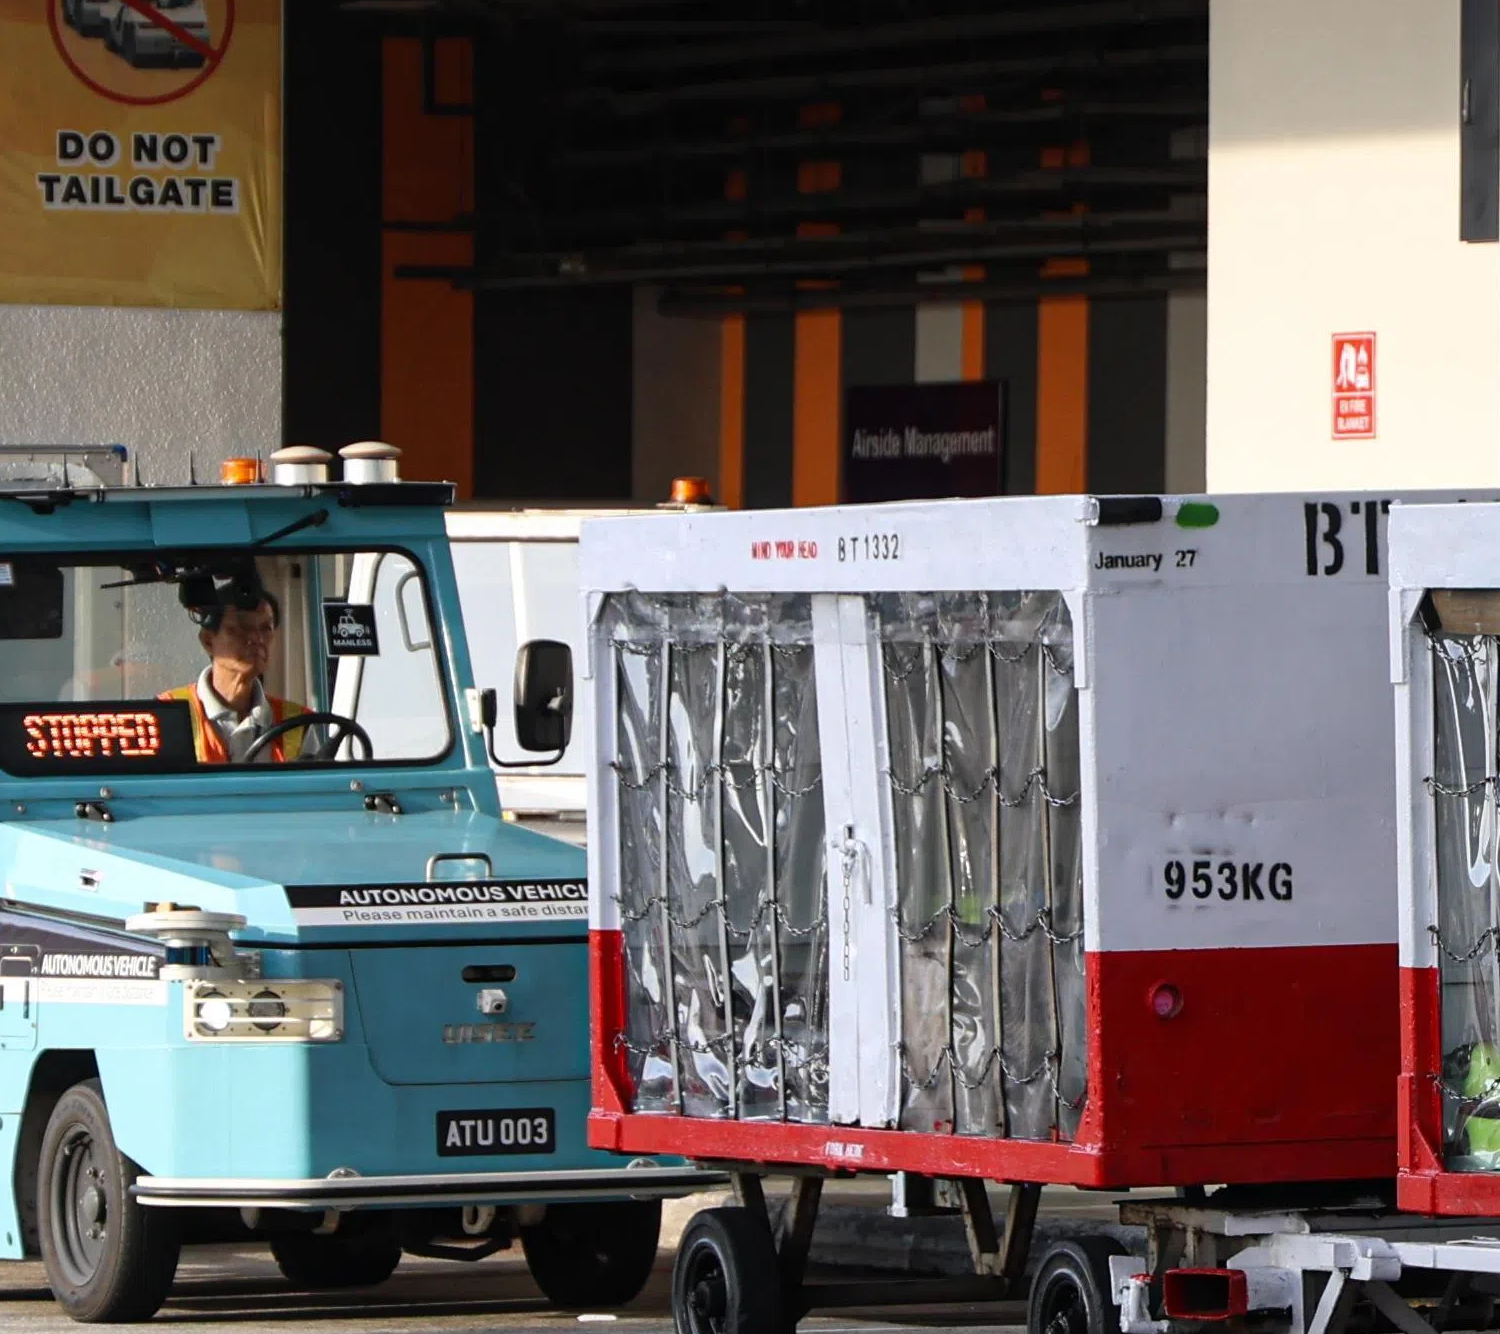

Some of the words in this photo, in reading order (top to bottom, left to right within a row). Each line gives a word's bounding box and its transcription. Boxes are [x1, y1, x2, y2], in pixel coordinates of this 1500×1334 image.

[58, 131, 115, 162] DO
[134, 133, 215, 164] NOT
[38, 174, 234, 208] TAILGATE
[852, 427, 899, 458] Airside
[904, 425, 996, 464] Management
[1305, 500, 1389, 576] BT
[1094, 549, 1162, 572] January
[1175, 548, 1197, 569] 27
[333, 638, 372, 647] MANLESS
[23, 712, 161, 757] STOPPED
[339, 884, 505, 906] AUTONOMOUS
[1164, 860, 1293, 901] 953KG
[343, 909, 402, 922] Please
[407, 907, 482, 920] maintain
[487, 908, 497, 917] a
[501, 904, 539, 918] safe
[40, 953, 113, 977] AUTONOMOUS
[114, 955, 156, 978] VEHICLE
[445, 1118, 494, 1147] ATU
[500, 1117, 548, 1145] 003
